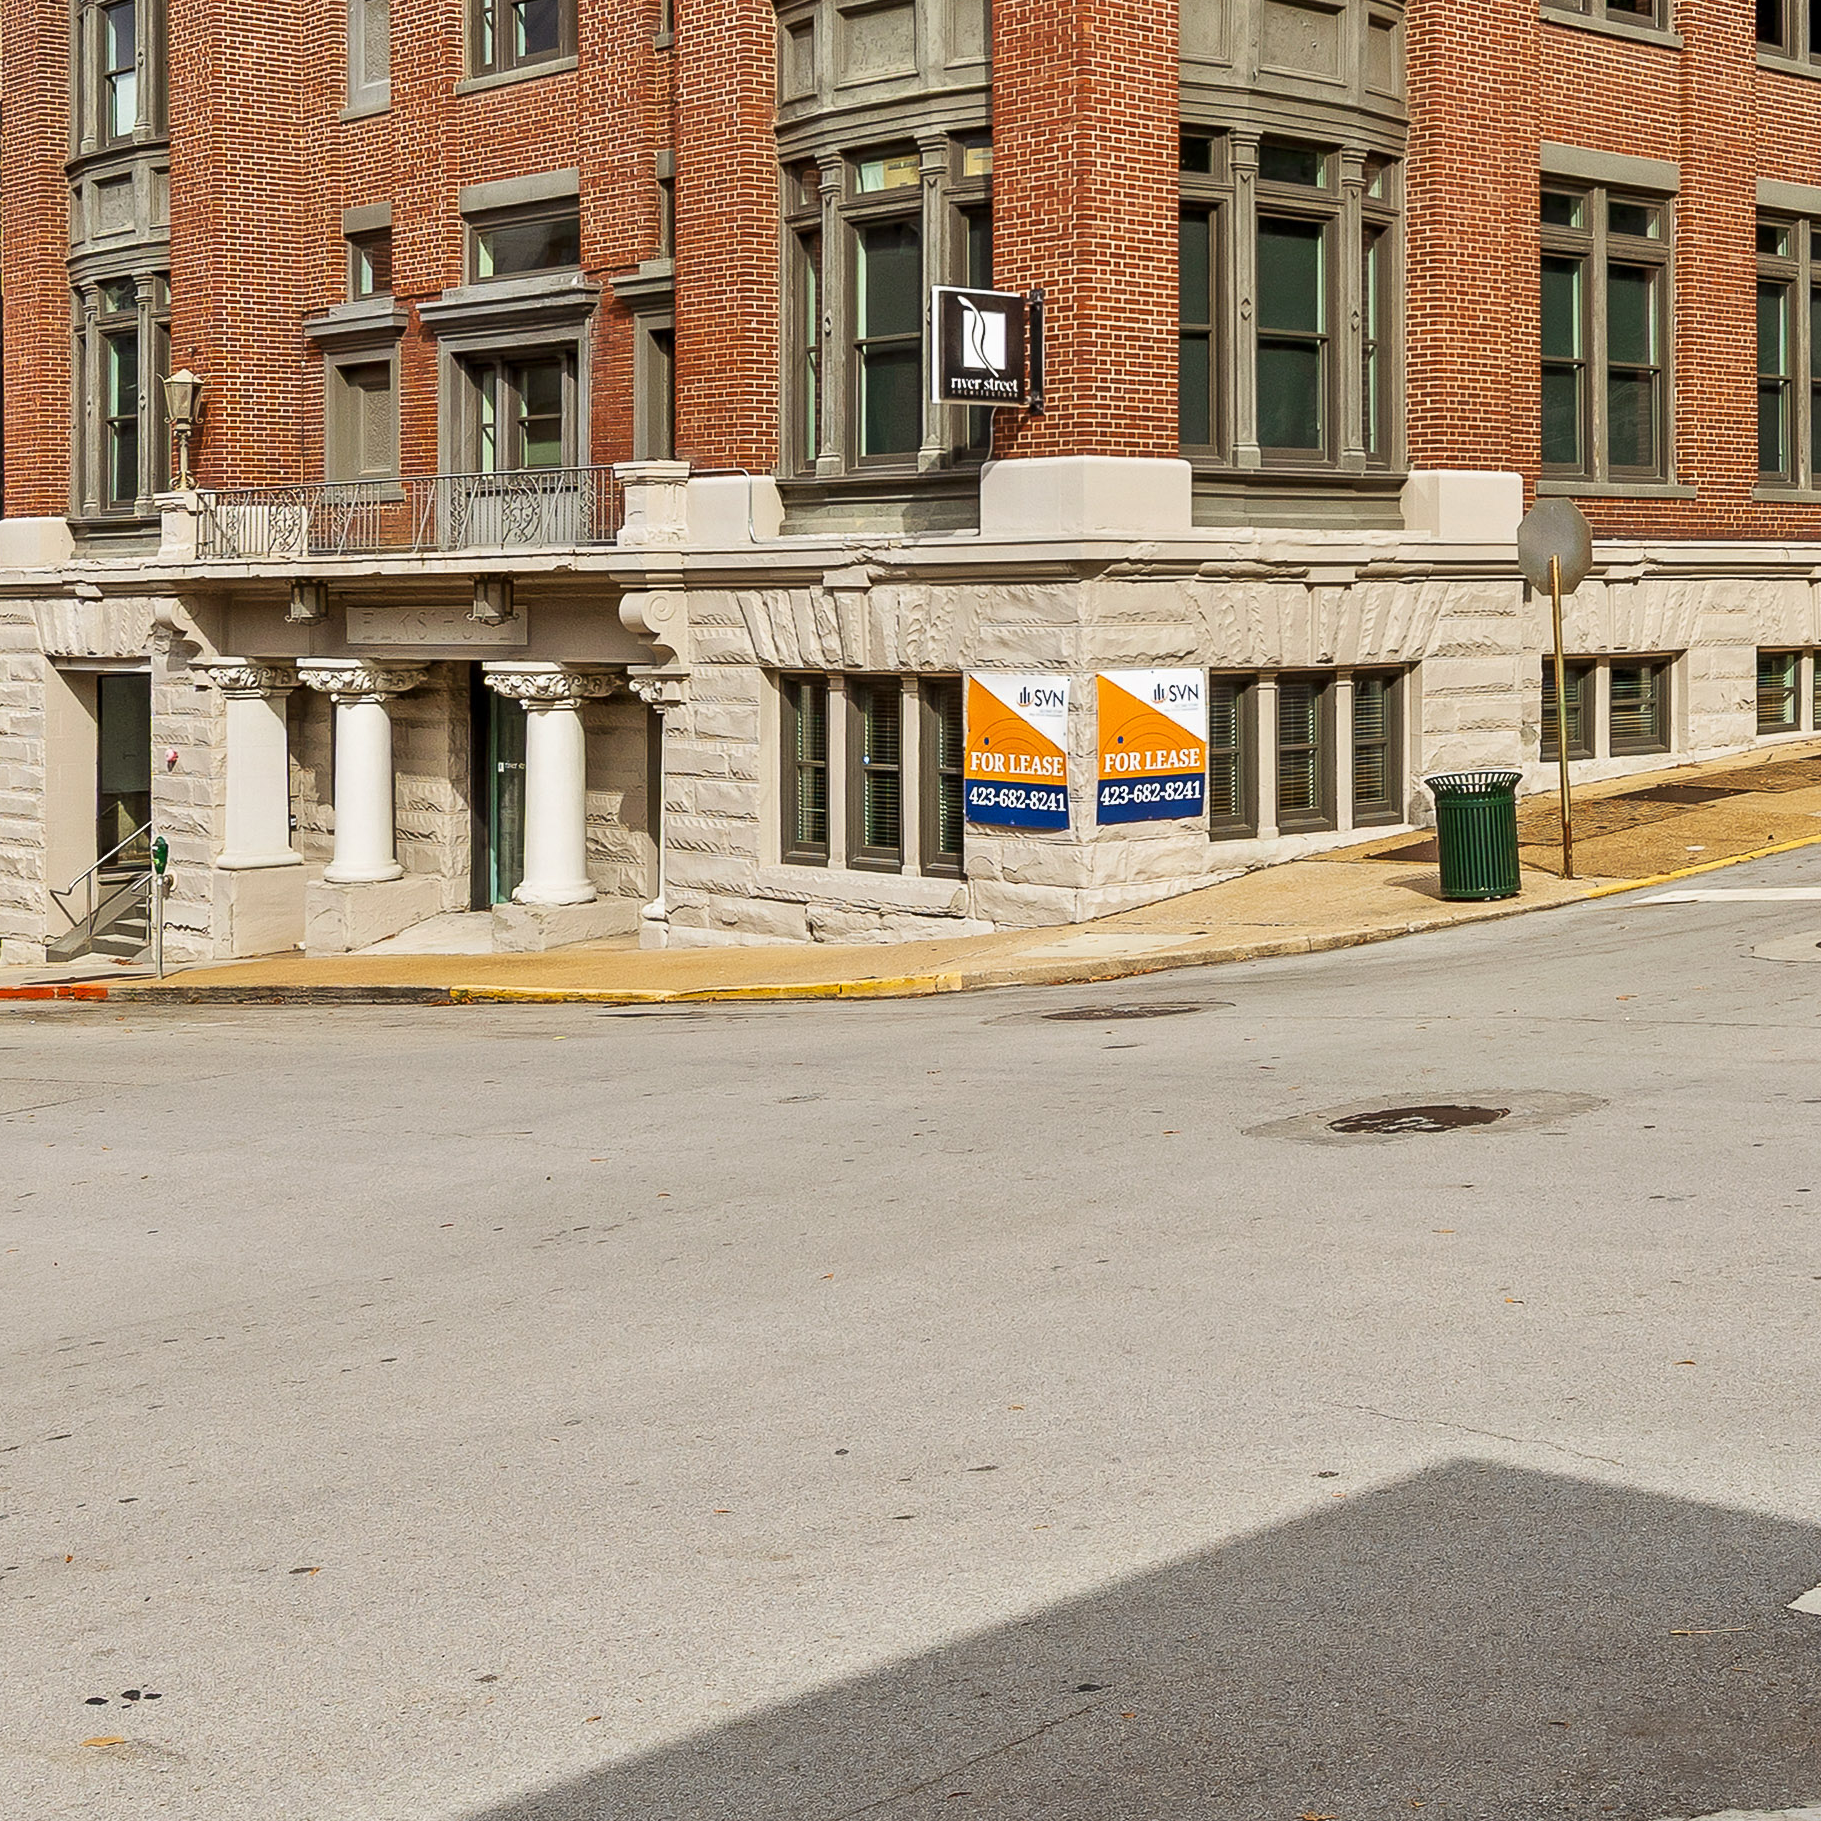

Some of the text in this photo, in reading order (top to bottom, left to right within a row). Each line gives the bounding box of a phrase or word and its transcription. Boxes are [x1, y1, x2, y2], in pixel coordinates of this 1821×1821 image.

[951, 377, 1018, 392] river street
[1034, 688, 1064, 707] SVN
[1168, 683, 1199, 703] SVN
[970, 751, 1064, 777] FOR LEASE
[1104, 747, 1201, 773] FOR LEASE
[969, 786, 1067, 812] 423-682-8241
[1100, 780, 1202, 806] 423-682-8241
